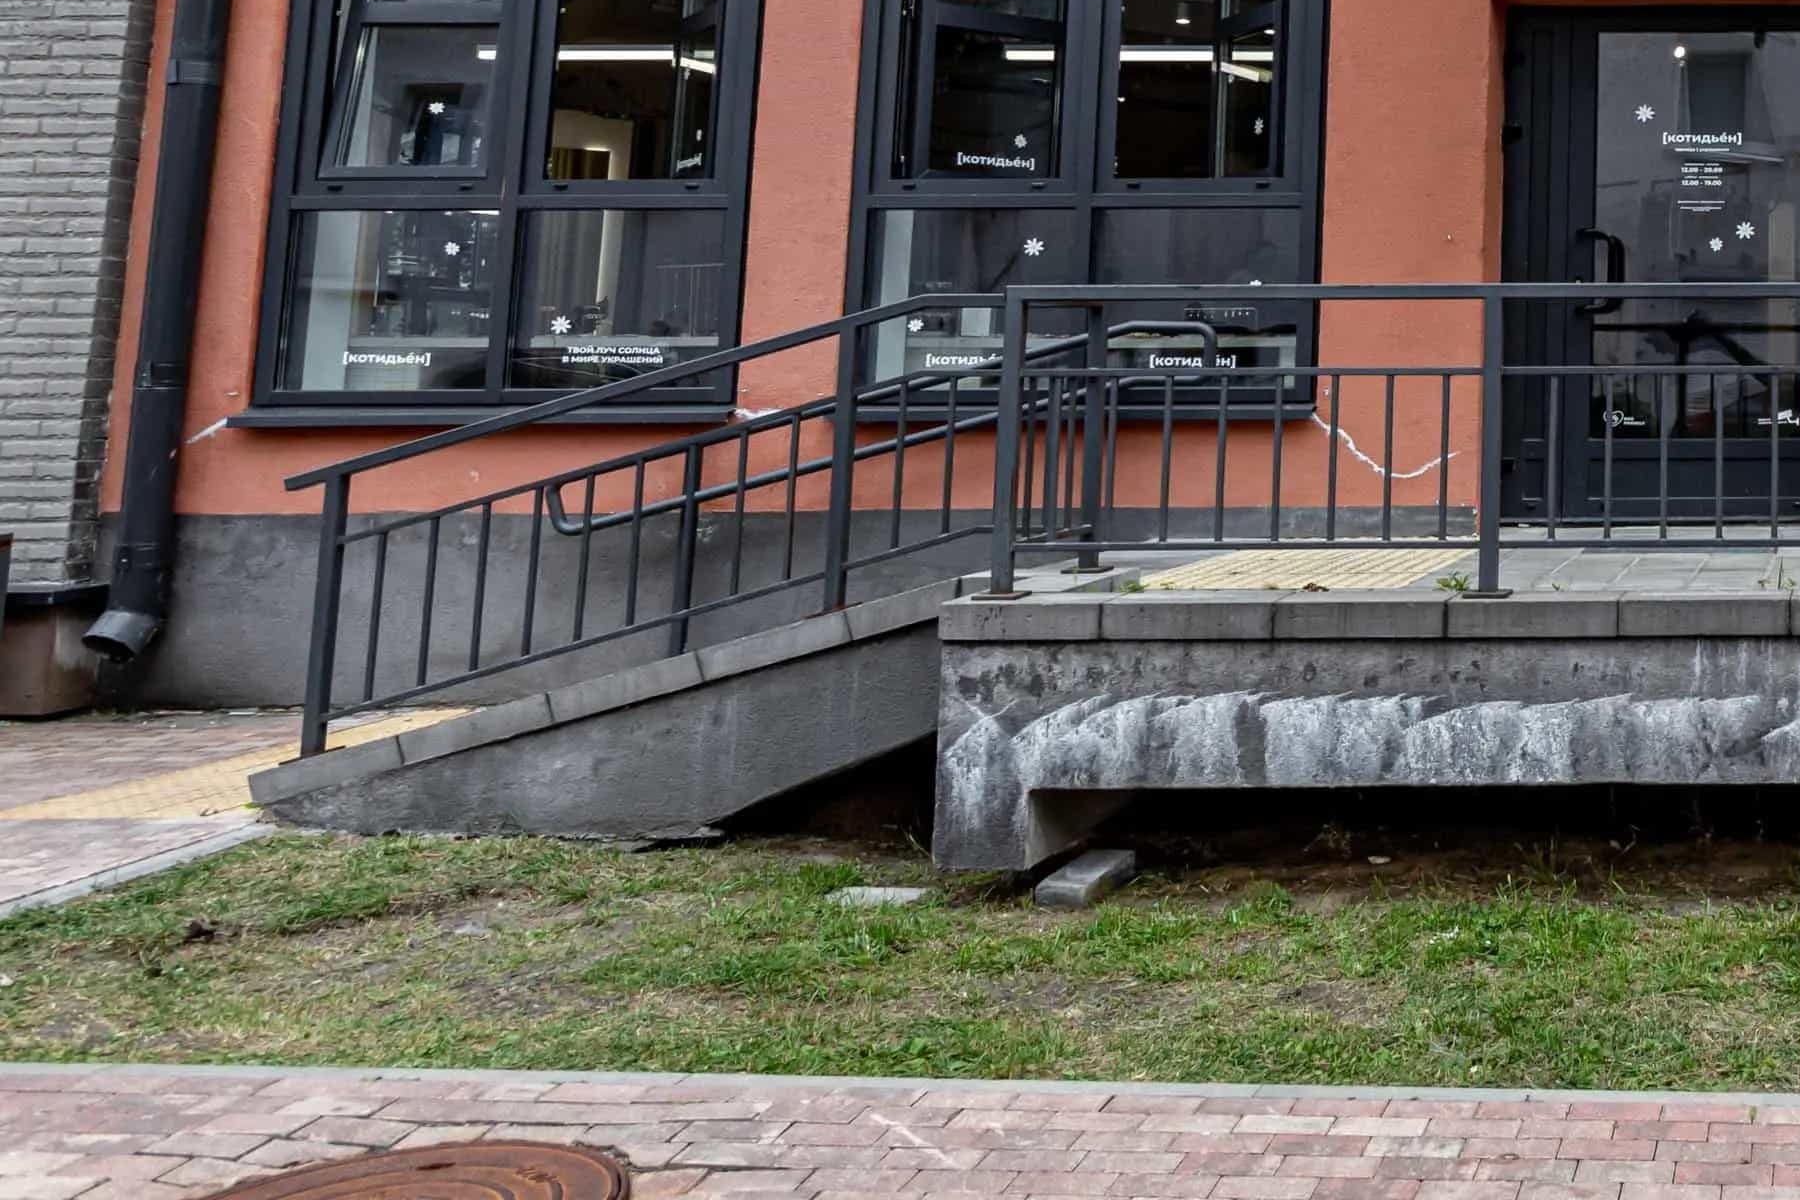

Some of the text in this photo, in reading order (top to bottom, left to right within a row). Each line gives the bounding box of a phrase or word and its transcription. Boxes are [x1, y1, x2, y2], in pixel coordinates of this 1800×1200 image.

[568, 345, 661, 355] ТВОЙ ЛУЧ СОЛНЦА
[571, 355, 599, 364] МИРЕ
[601, 355, 664, 364] УКРАШЕНИЙ
